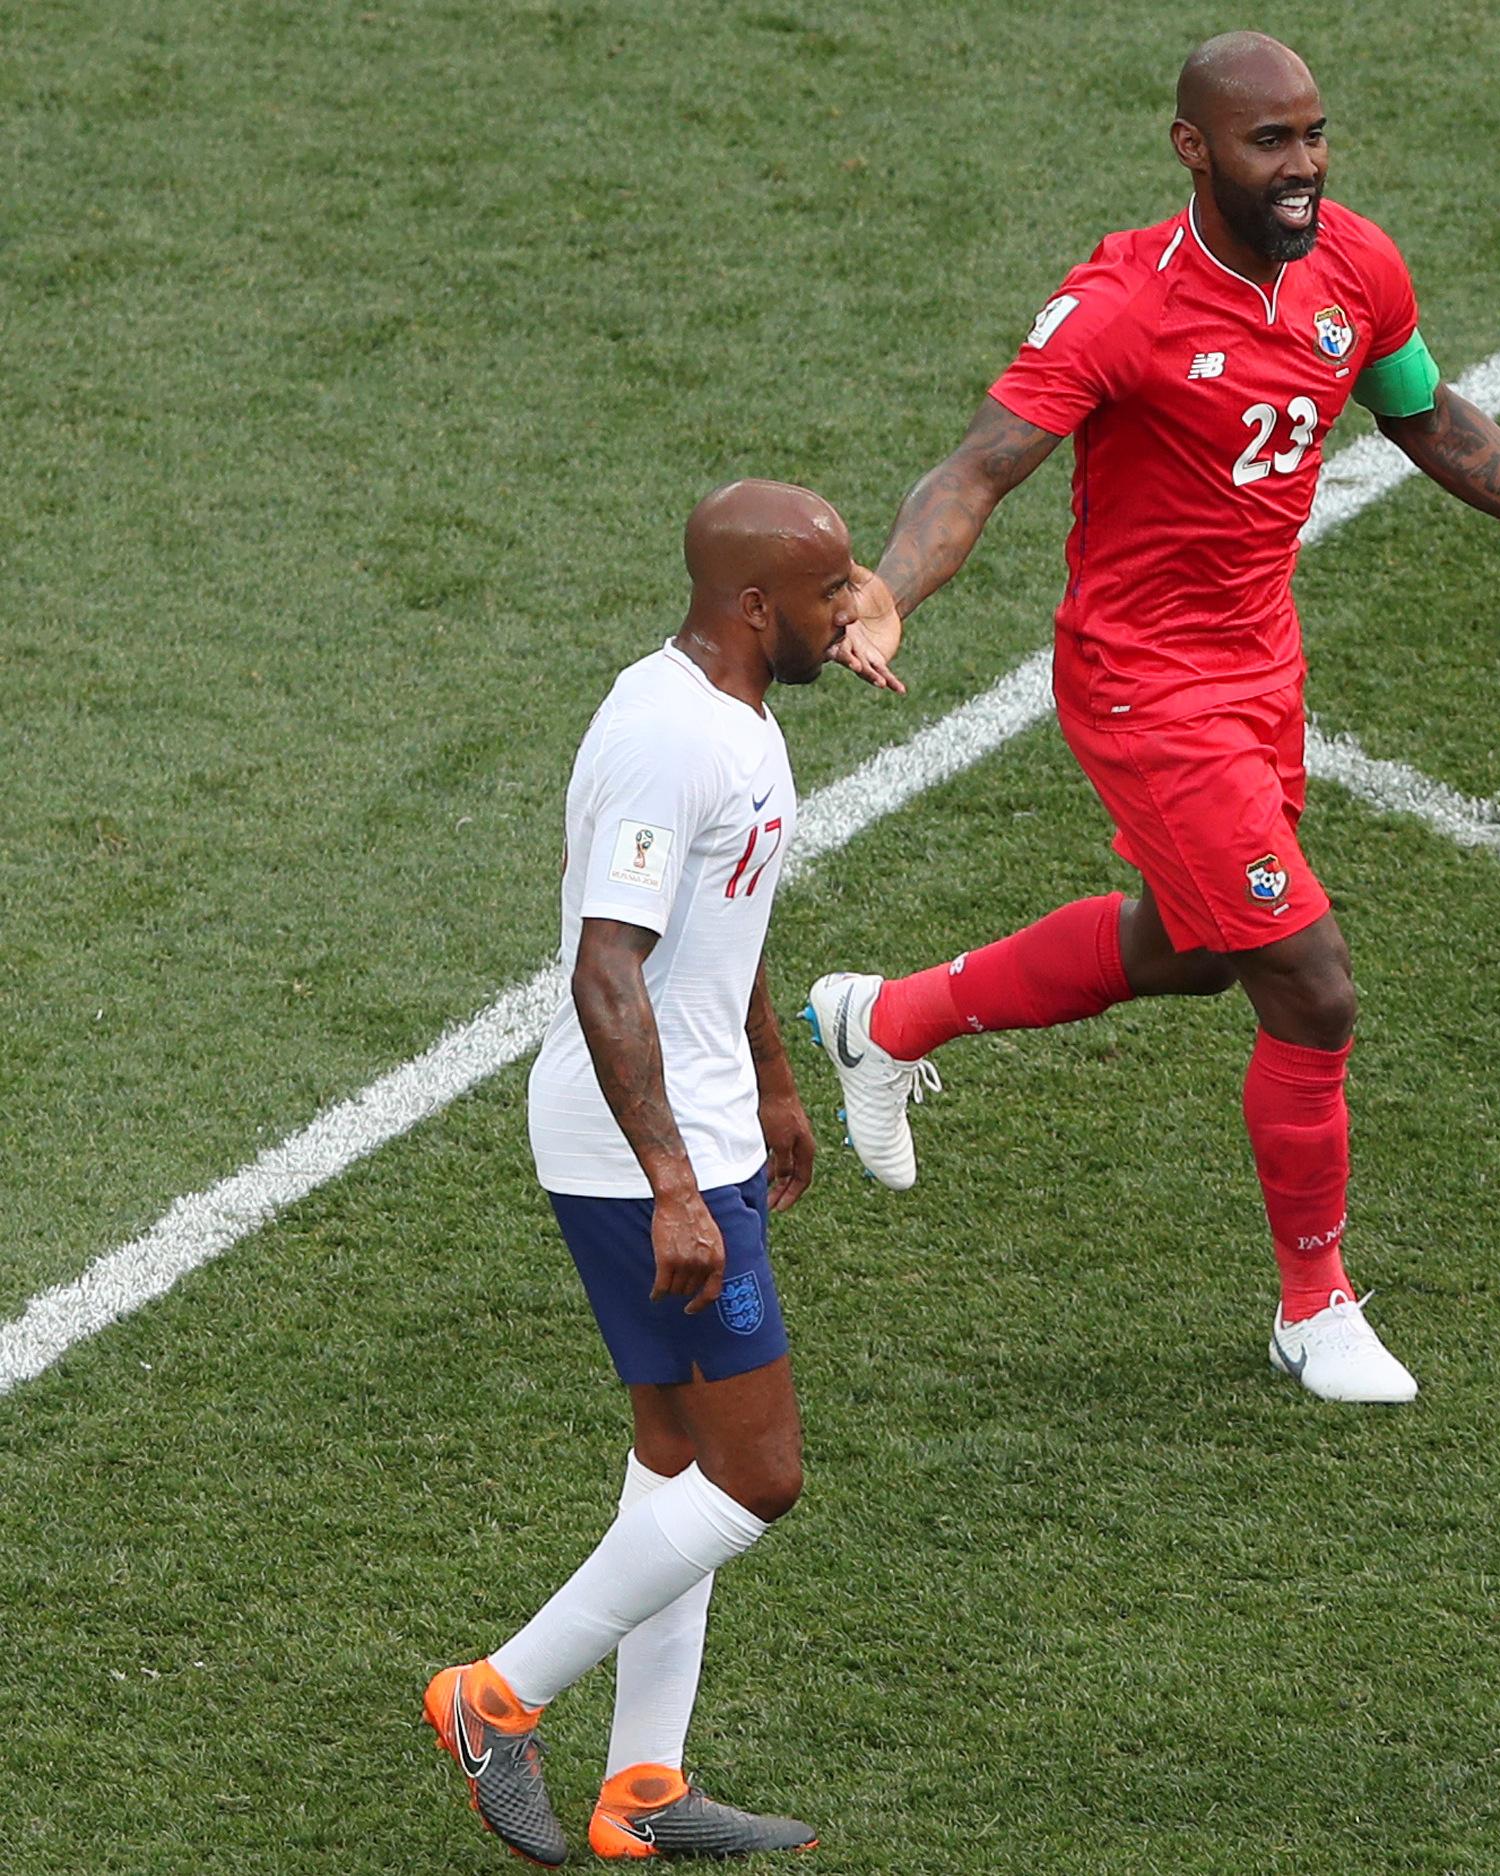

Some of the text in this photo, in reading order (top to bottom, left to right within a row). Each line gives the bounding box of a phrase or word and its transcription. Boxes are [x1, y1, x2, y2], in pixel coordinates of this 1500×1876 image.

[1187, 352, 1225, 379] NB
[1232, 396, 1318, 486] 23
[725, 816, 781, 898] 17
